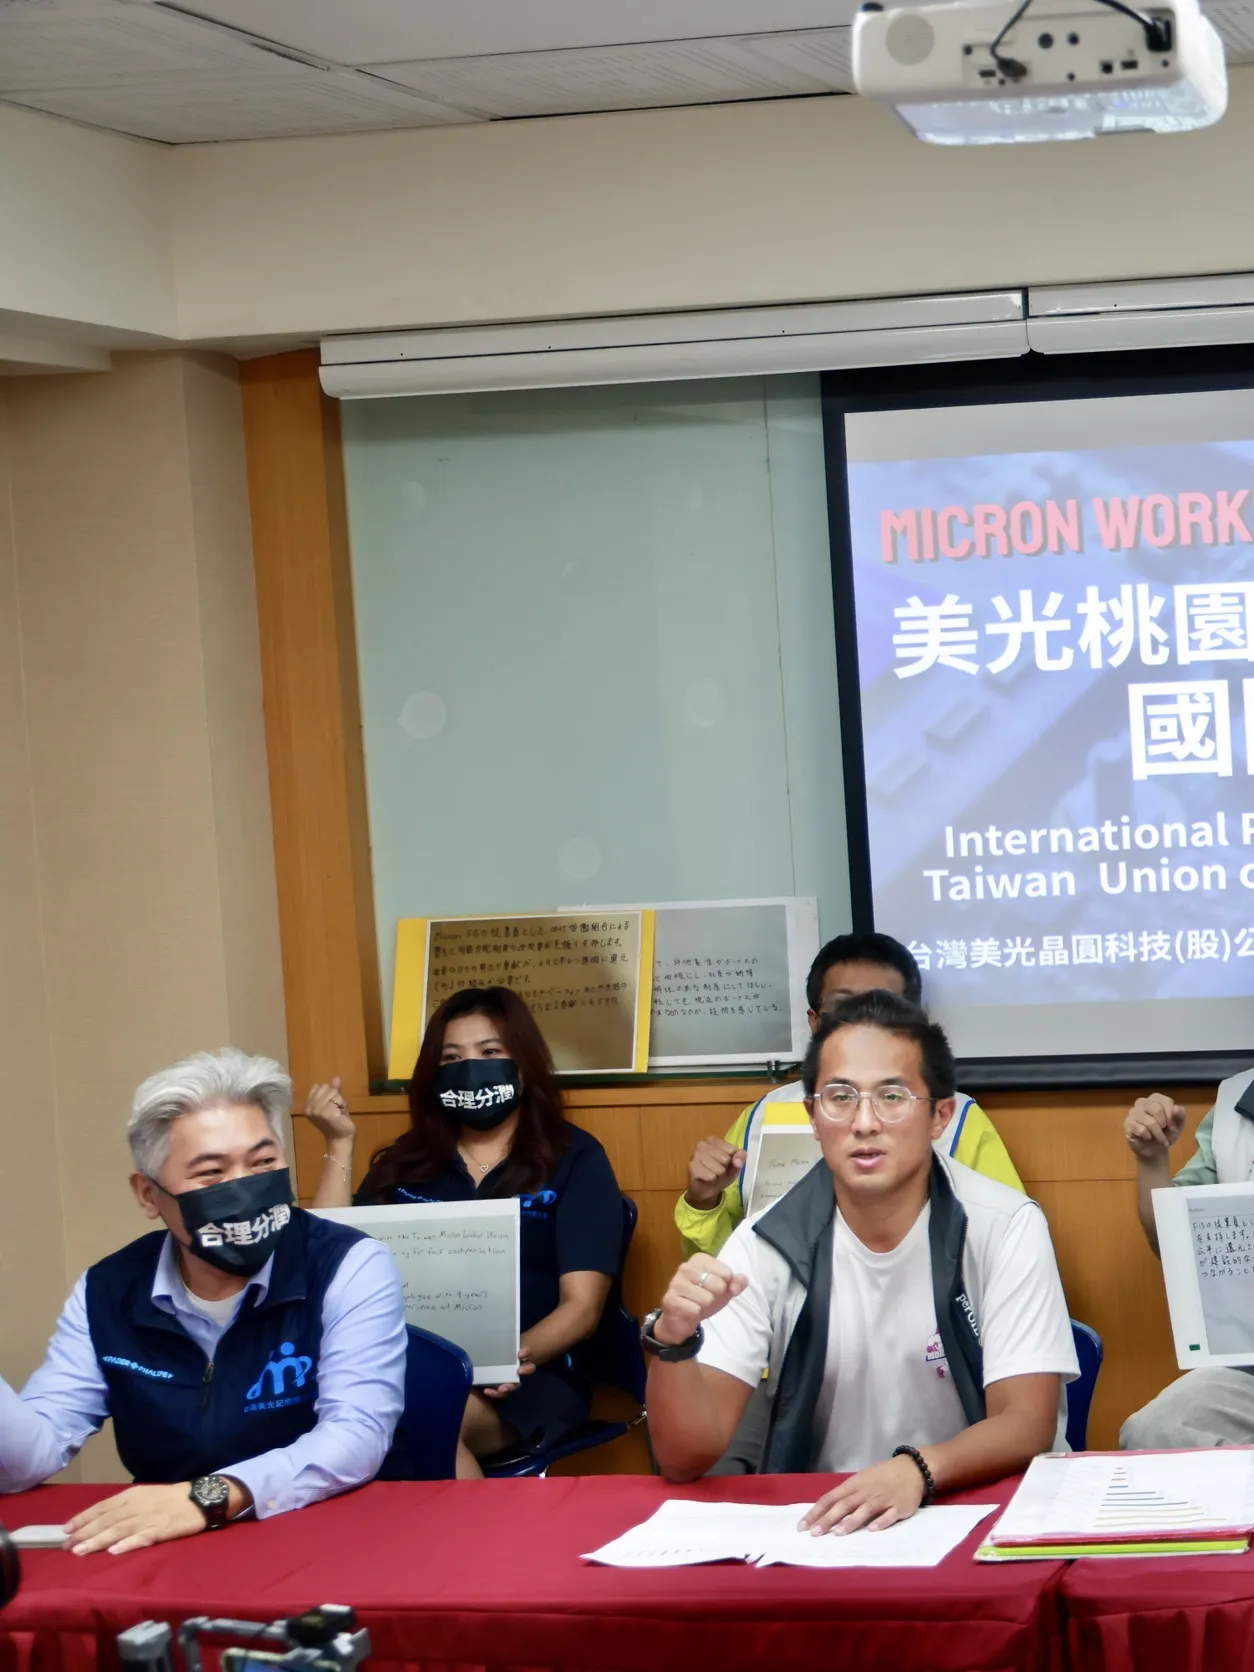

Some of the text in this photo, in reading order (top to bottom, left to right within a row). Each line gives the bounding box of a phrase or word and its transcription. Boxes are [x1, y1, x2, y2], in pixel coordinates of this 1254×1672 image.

[880, 498, 1081, 563] MICRON
[945, 812, 1227, 857] International
[925, 865, 1076, 901] Taiwan
[1100, 857, 1213, 895] Union
[439, 1084, 515, 1109] 合理分潤
[197, 1203, 291, 1247] 合理分潤
